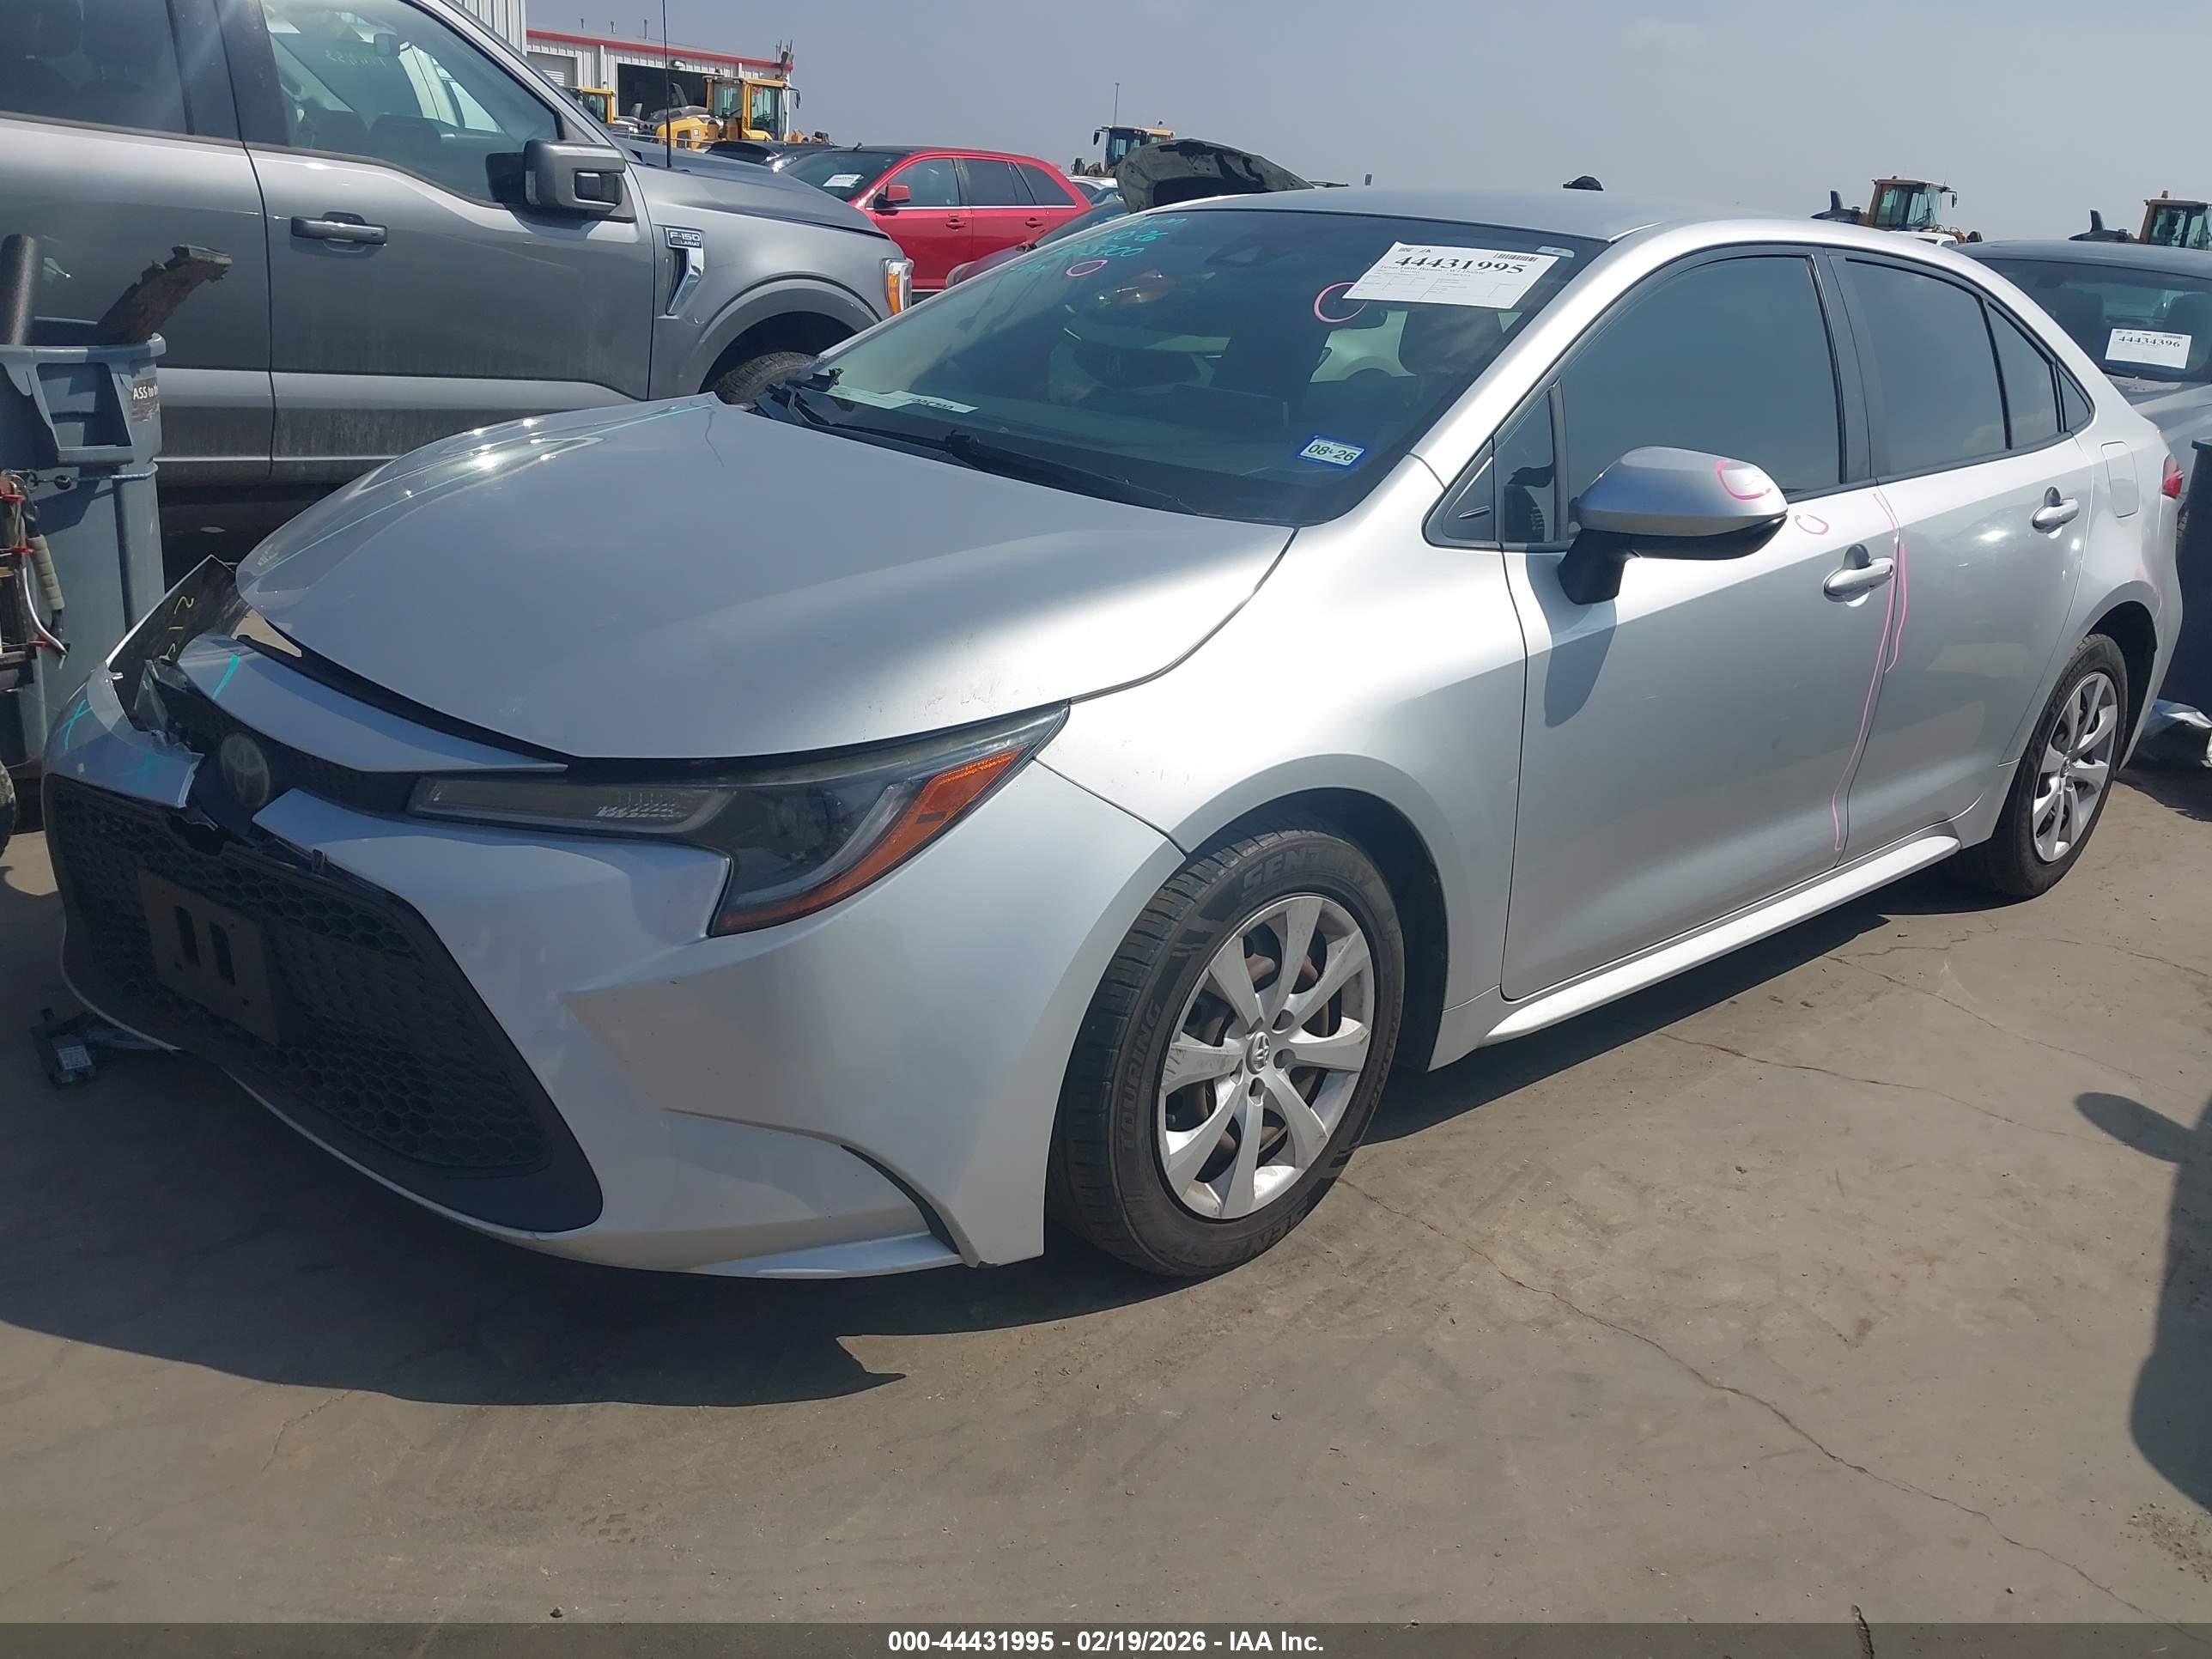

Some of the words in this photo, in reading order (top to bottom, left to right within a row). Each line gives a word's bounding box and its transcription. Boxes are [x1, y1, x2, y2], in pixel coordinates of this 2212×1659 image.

[670, 232, 702, 241] F-150
[1395, 256, 1528, 275] 44431995
[2118, 336, 2181, 348] 44434396
[1308, 444, 1330, 455] 08
[1333, 450, 1357, 461] 26
[1121, 999, 1161, 1153] TOURING
